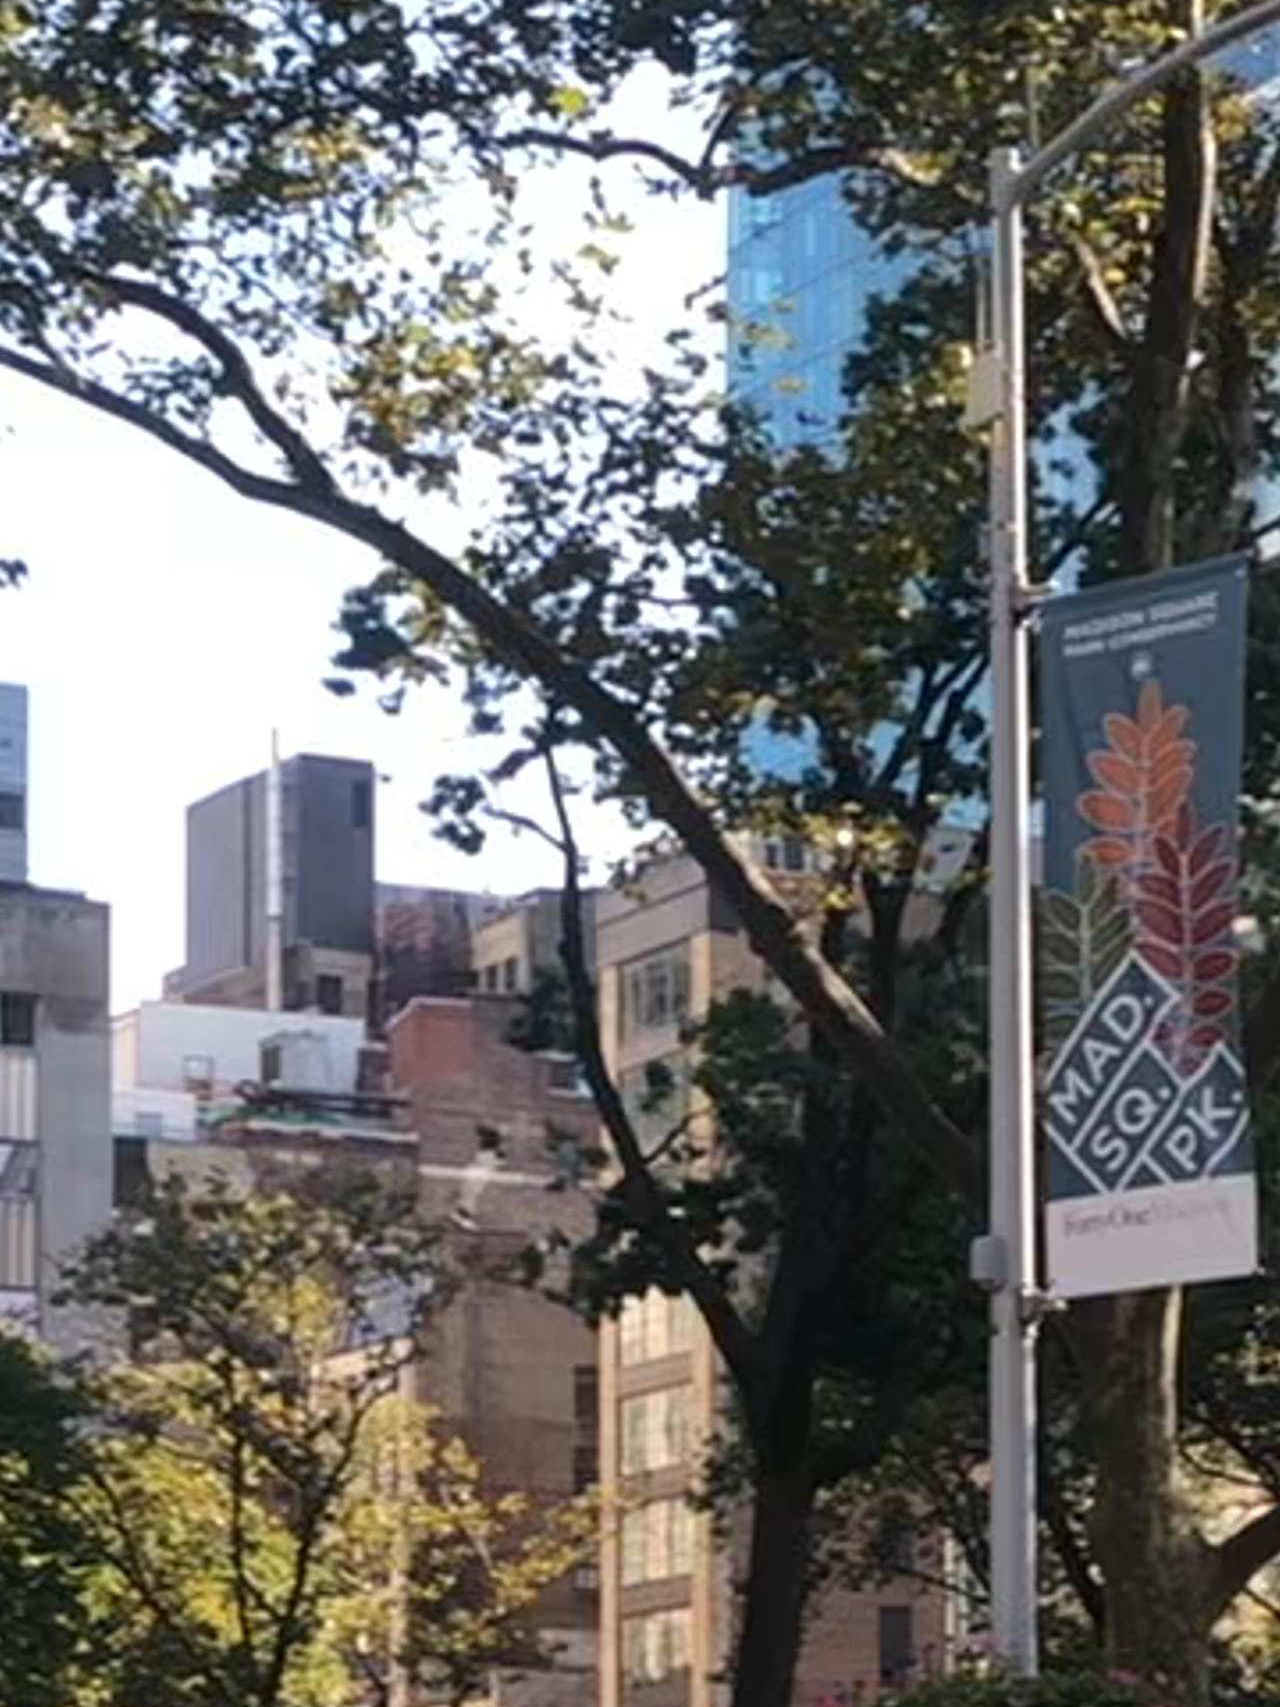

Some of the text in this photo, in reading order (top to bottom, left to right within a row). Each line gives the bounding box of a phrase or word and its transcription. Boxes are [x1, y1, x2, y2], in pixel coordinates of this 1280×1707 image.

[1048, 995, 1154, 1125] MAD.
[1090, 1087, 1170, 1171] SQ.
[1164, 1086, 1243, 1171] PK.
